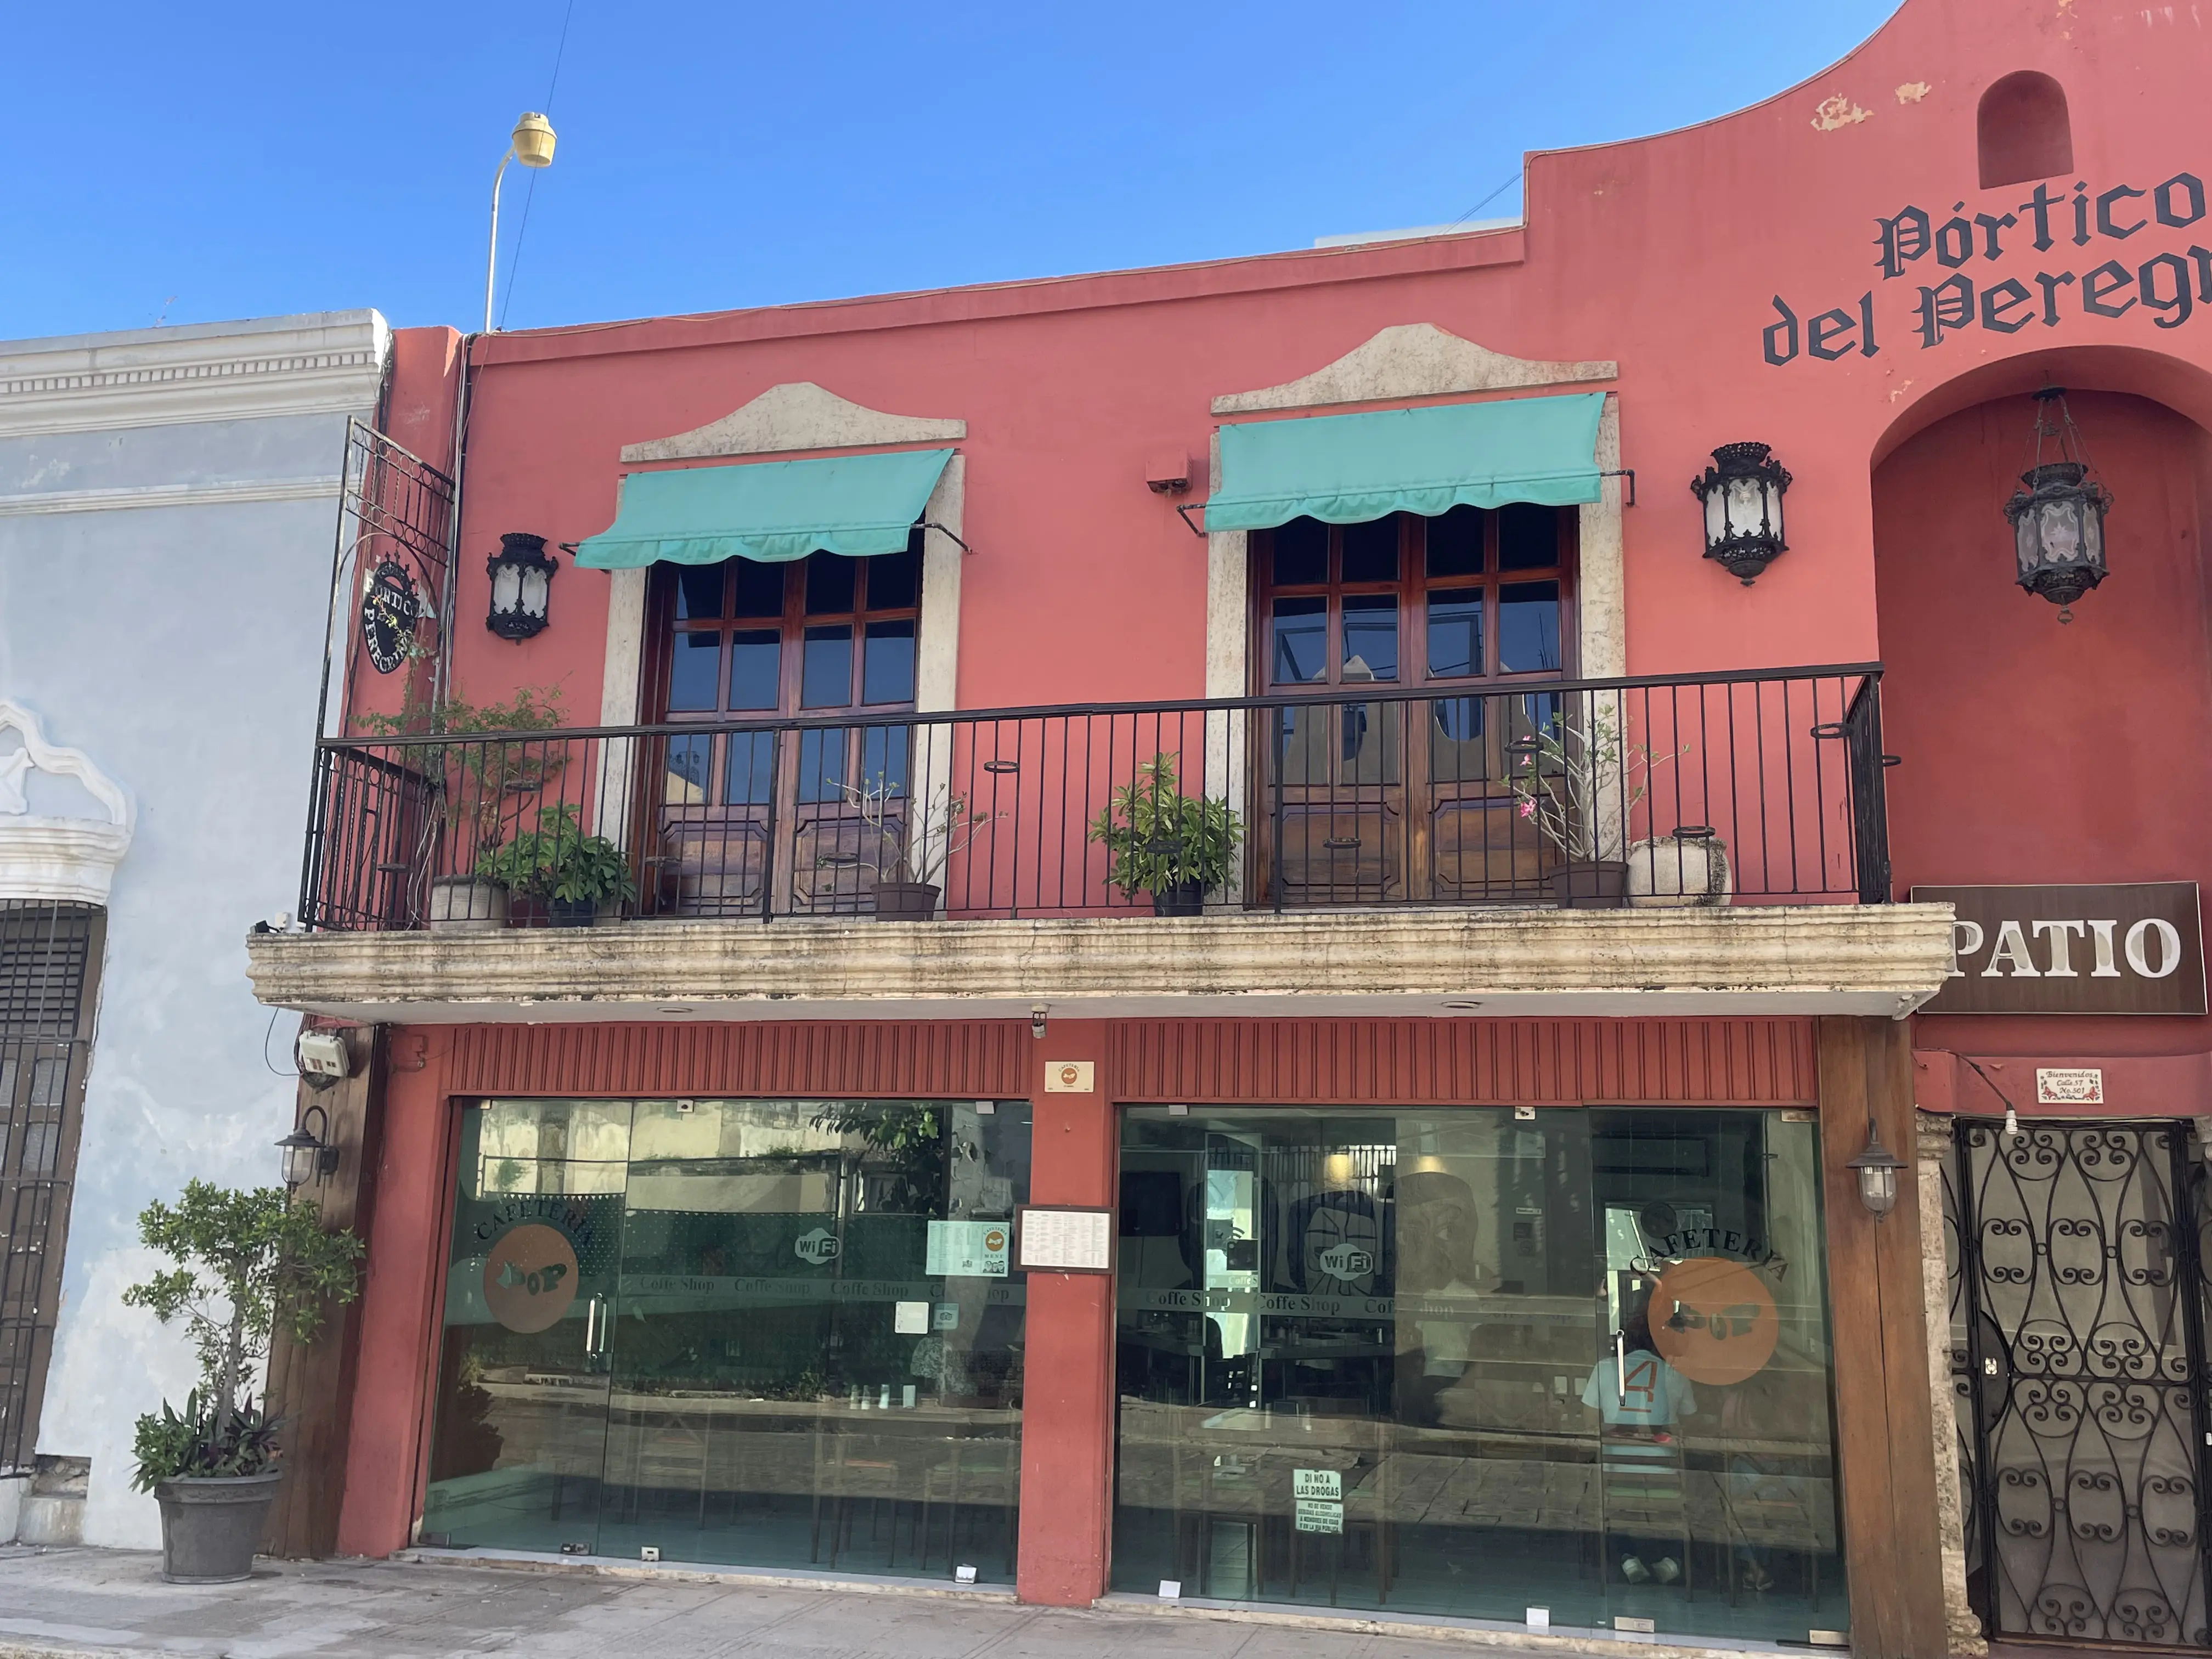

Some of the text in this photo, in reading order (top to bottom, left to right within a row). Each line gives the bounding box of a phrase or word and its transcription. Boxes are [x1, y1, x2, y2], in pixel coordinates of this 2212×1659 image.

[1872, 172, 2207, 281] Pórtico
[1763, 290, 1880, 366] del
[1947, 918, 2181, 978] PATIO
[477, 1199, 592, 1246] CAFETERIA
[1630, 1228, 1788, 1283] CAFETERIA
[680, 1278, 714, 1294] Shop
[873, 1283, 909, 1299] Shop
[1296, 1485, 1339, 1497] LAS DROGAS
[1305, 1473, 1330, 1484] DI NO A
